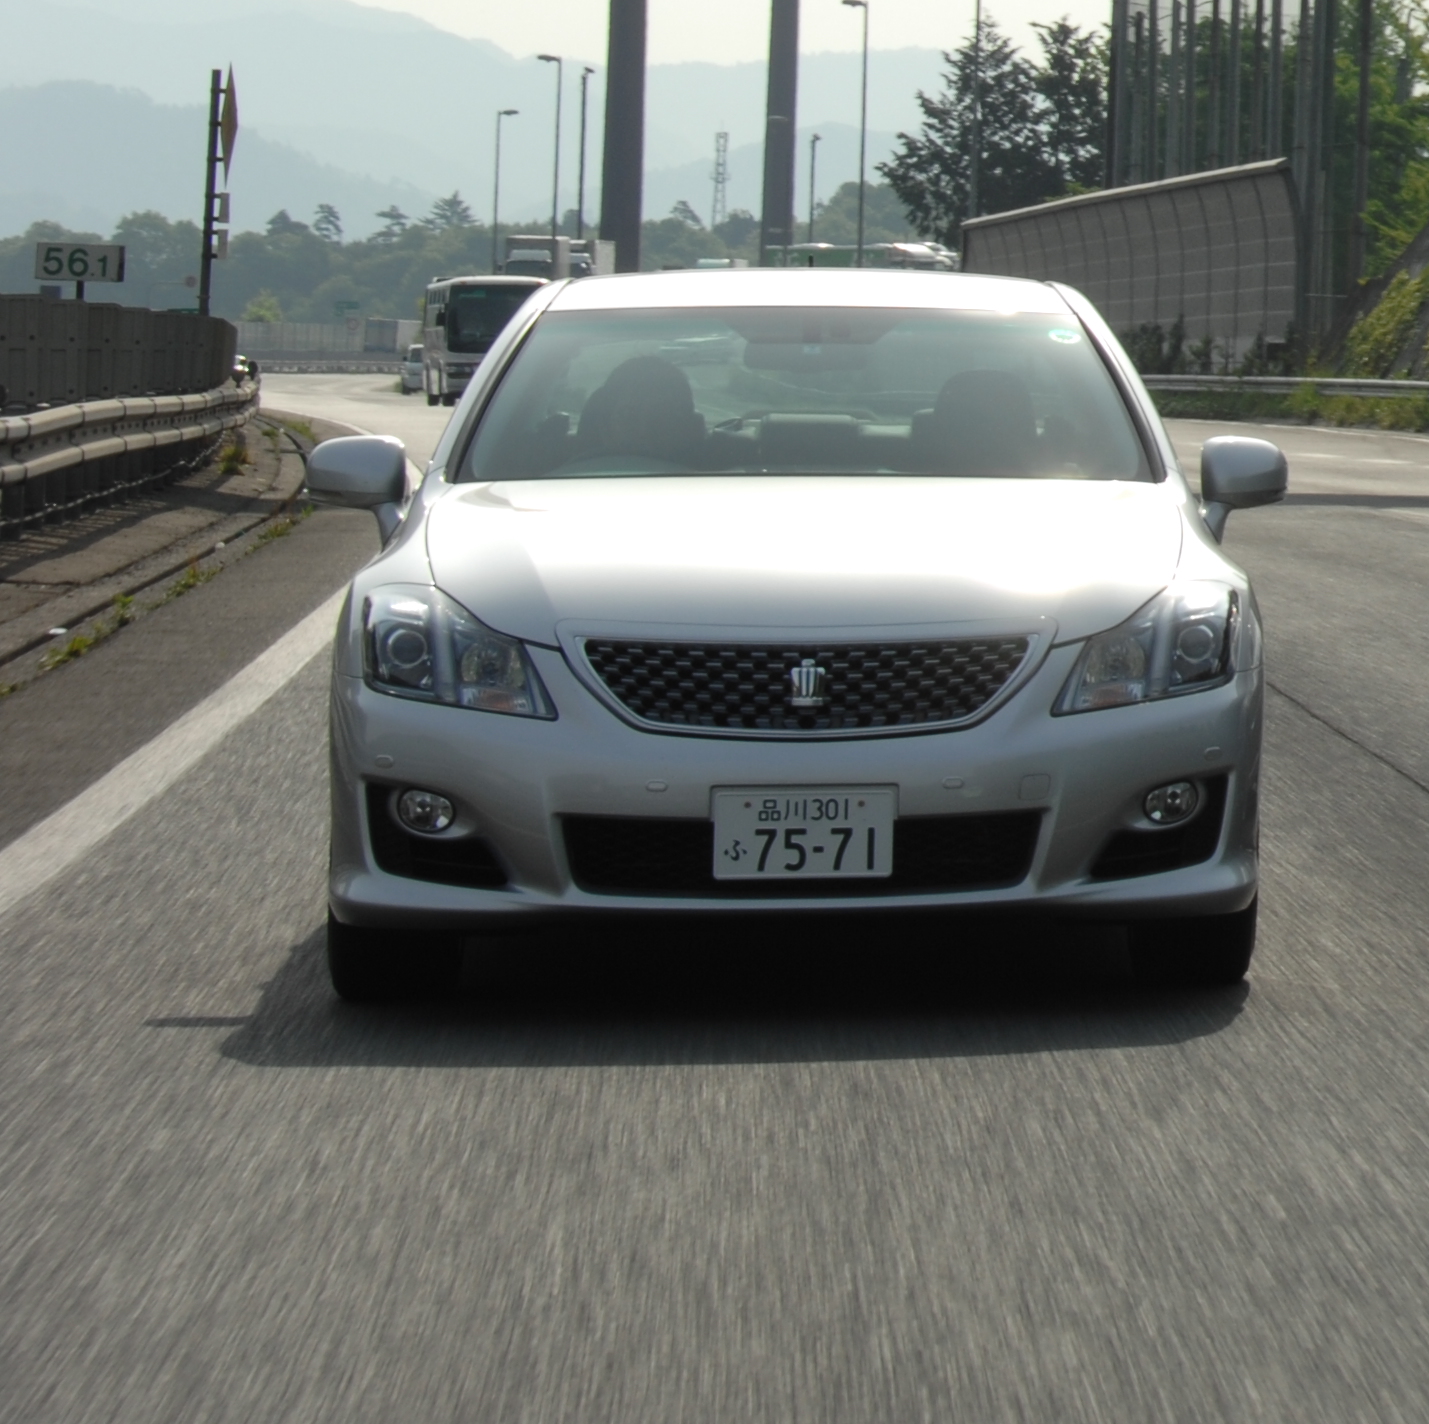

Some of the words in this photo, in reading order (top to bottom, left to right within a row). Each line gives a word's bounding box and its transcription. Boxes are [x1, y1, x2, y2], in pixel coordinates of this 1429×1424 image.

[43, 247, 108, 277] 56.1
[723, 839, 748, 861] ふ
[754, 827, 875, 872] 75-71
